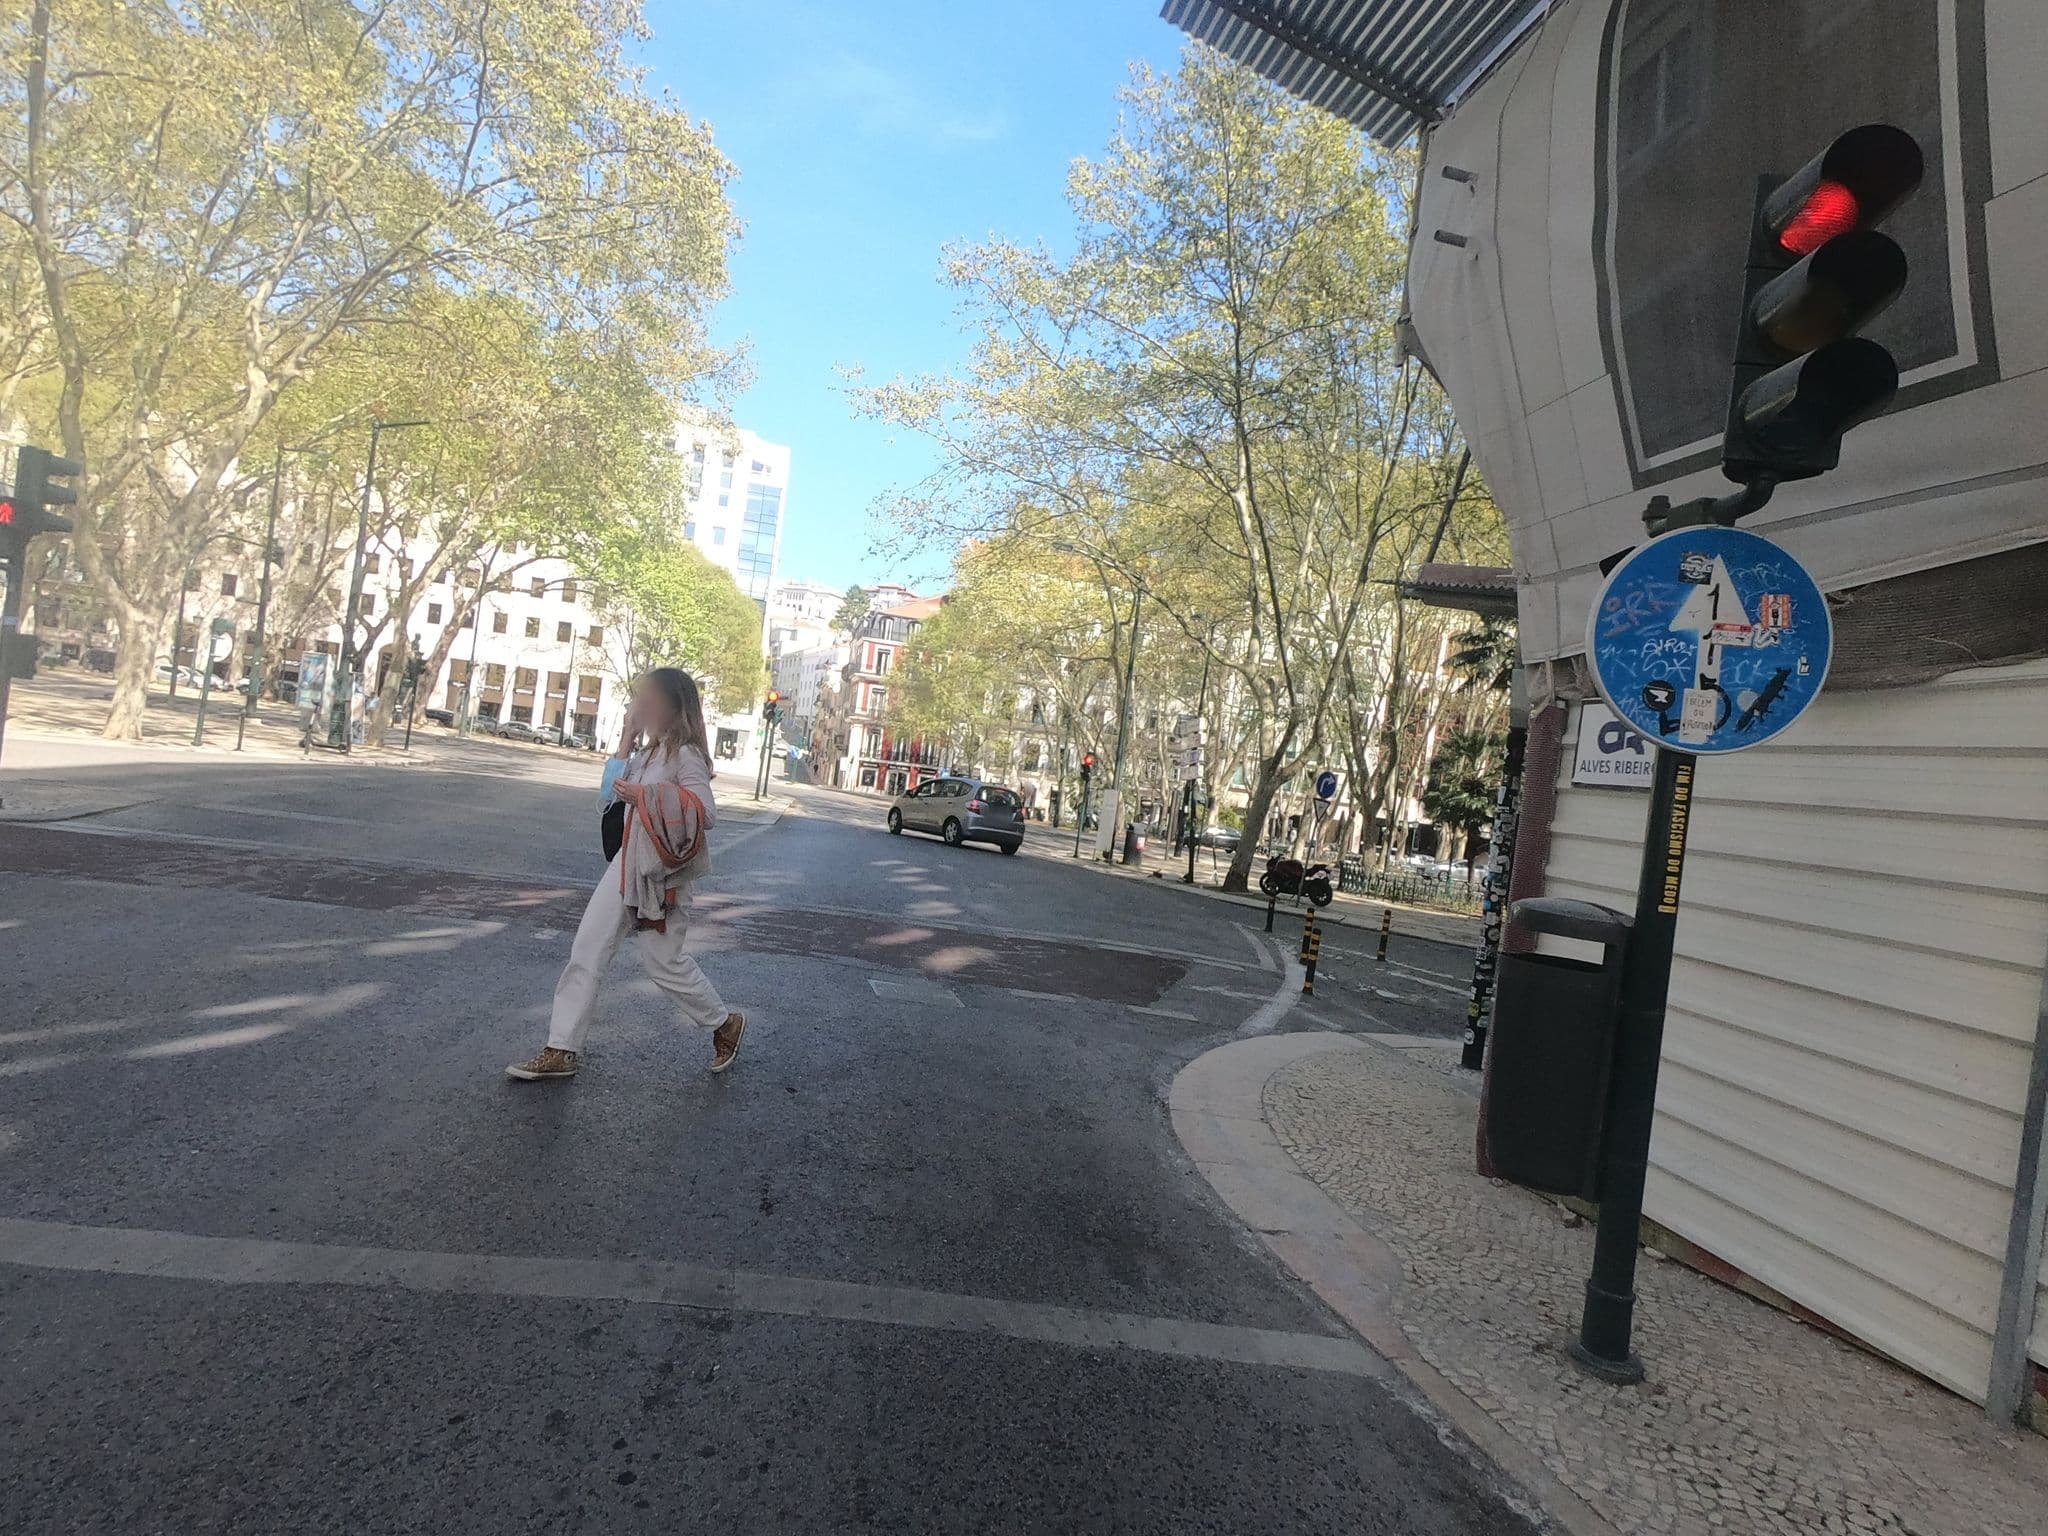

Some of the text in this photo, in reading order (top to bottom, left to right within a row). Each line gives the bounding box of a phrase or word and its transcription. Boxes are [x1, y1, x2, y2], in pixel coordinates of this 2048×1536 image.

[1580, 760, 1610, 774] ALVES
[1663, 765, 1691, 904] FIM DO FASCISMO DO MEDO
